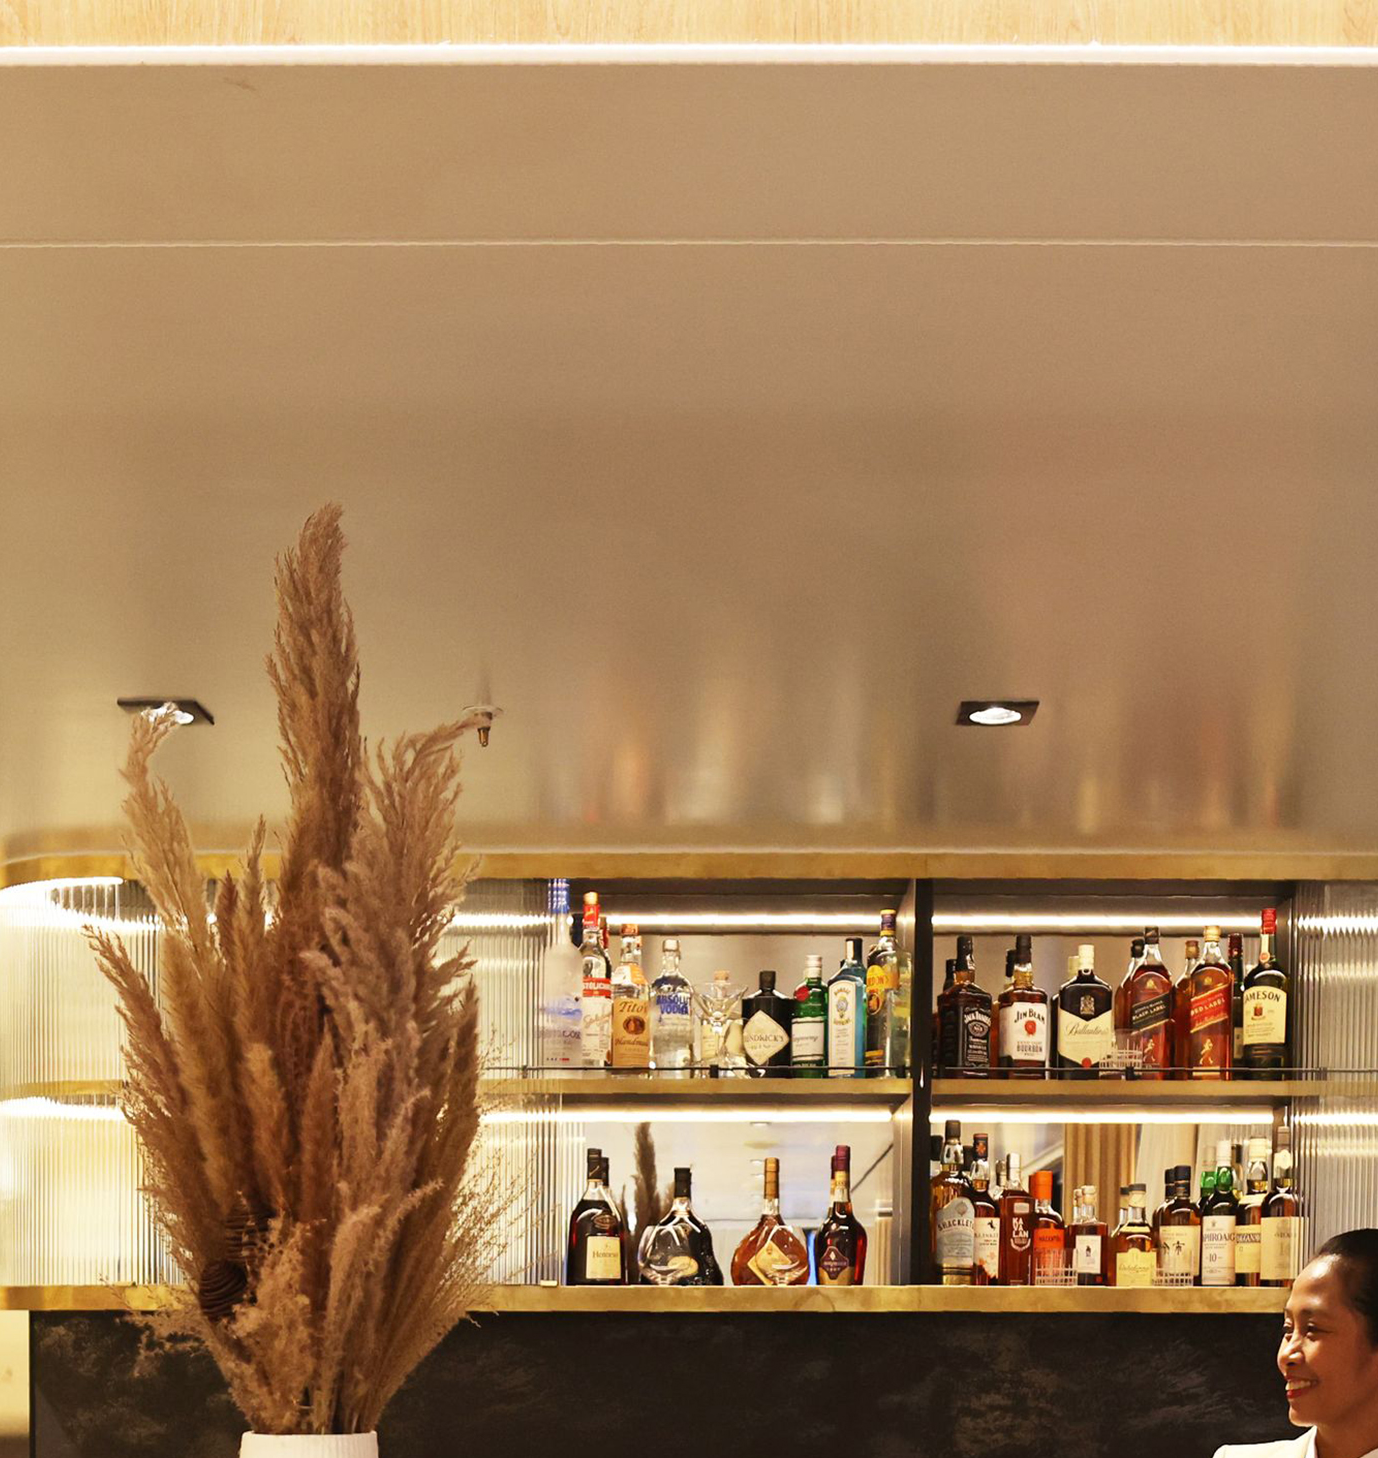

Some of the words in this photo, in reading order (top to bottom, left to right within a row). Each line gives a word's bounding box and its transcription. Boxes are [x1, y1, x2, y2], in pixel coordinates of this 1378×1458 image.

[1244, 990, 1281, 1004] AMESON
[660, 1004, 689, 1015] VODKA
[1150, 1004, 1166, 1014] LABEL
[1205, 998, 1225, 1011] LABEL
[937, 1219, 974, 1232] SHACKLET
